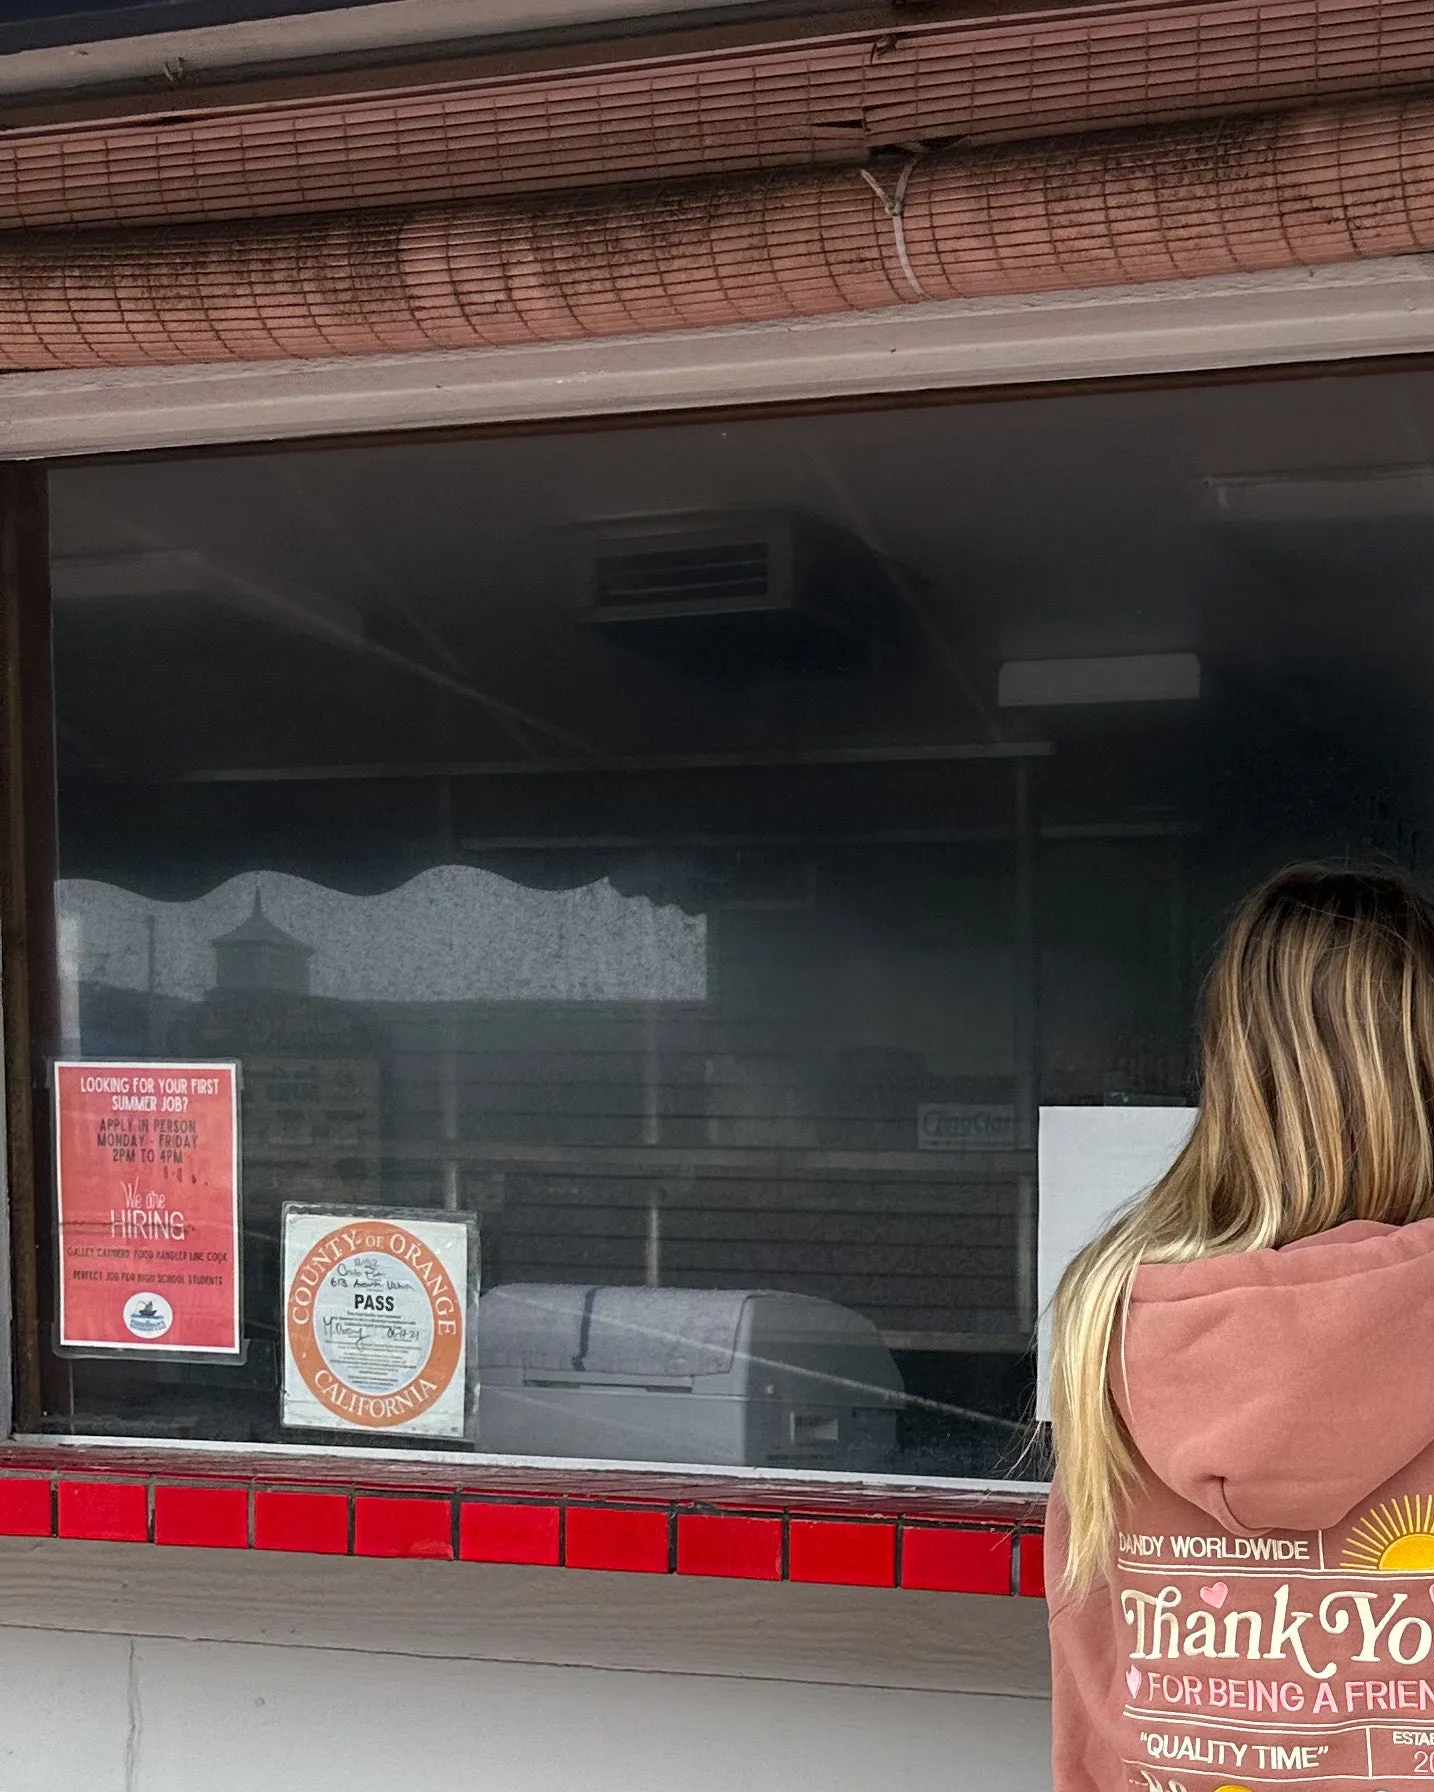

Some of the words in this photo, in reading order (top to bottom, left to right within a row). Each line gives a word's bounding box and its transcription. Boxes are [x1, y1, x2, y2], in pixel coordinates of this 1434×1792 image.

[80, 1077, 129, 1093] LOOKING
[133, 1078, 154, 1094] FOR
[158, 1078, 188, 1095] YOUR
[191, 1078, 219, 1095] FIRST
[112, 1095, 157, 1111] SUMMER
[161, 1096, 188, 1112] JOB?
[99, 1118, 133, 1132] APPLY
[138, 1119, 149, 1132] IN
[153, 1119, 196, 1134] PERSON
[97, 1134, 145, 1147] MONDAY
[159, 1135, 198, 1148] FRIDAY
[112, 1149, 135, 1162] 2PM
[141, 1149, 154, 1163] TO
[160, 1149, 183, 1163] 4PM
[120, 1176, 142, 1209] We
[145, 1190, 166, 1209] are
[110, 1209, 185, 1240] HIRING
[291, 1230, 360, 1326] COUNTY
[365, 1234, 385, 1250] OF
[389, 1233, 457, 1336] ORANGE
[354, 1294, 395, 1312] PASS
[314, 1368, 438, 1419] CALIFORNIA
[1118, 1532, 1165, 1558] DANDY
[1170, 1535, 1311, 1561] WORLDWIDE
[1120, 1583, 1338, 1679] Thank
[1147, 1672, 1203, 1705] FOR
[1208, 1676, 1305, 1713] BEING
[1312, 1682, 1340, 1713] A
